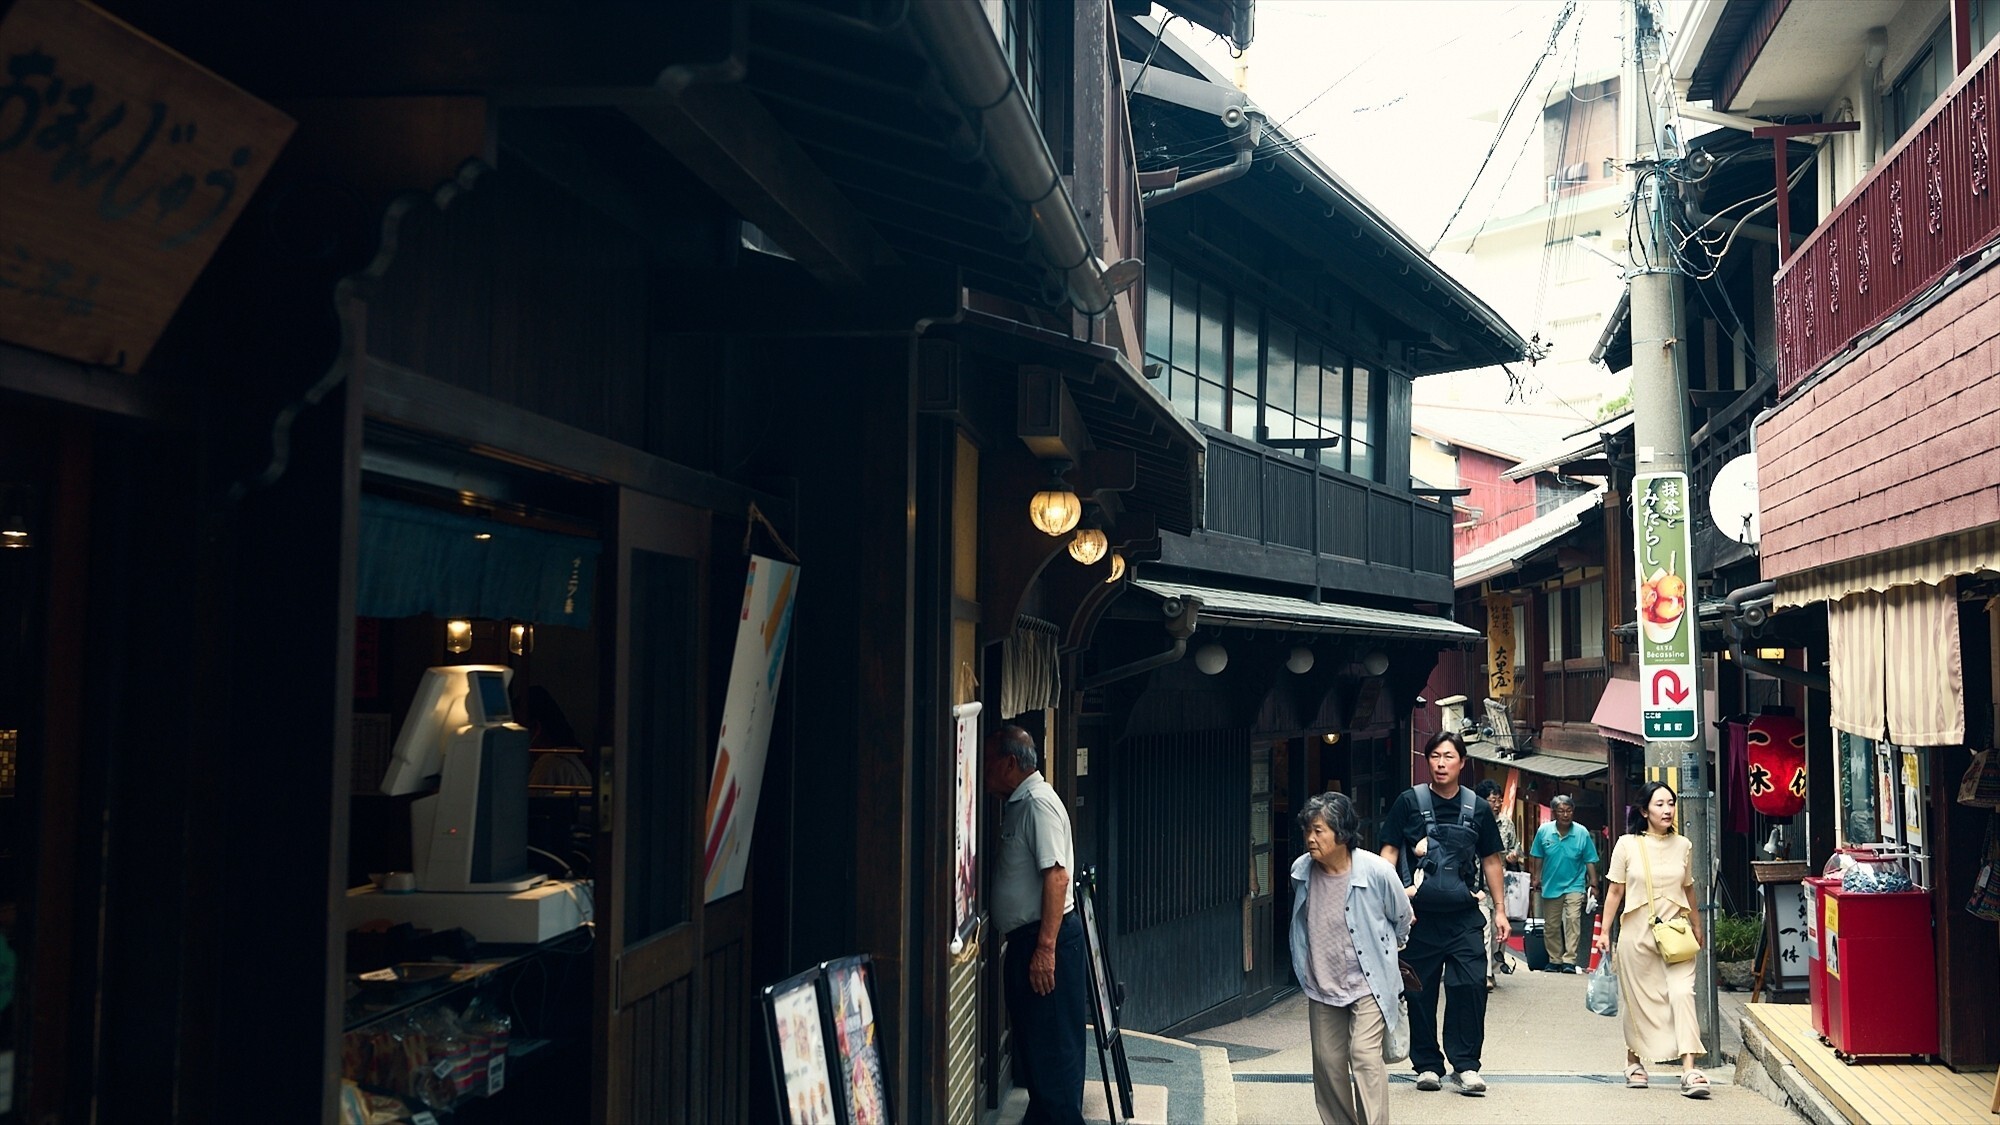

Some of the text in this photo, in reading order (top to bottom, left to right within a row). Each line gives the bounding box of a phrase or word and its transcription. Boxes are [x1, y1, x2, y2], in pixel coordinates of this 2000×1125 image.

[1640, 488, 1660, 566] みたらし
[1661, 481, 1680, 528] 抹茶と
[1491, 645, 1511, 689] 大黒屋
[1780, 927, 1800, 963] 一休
